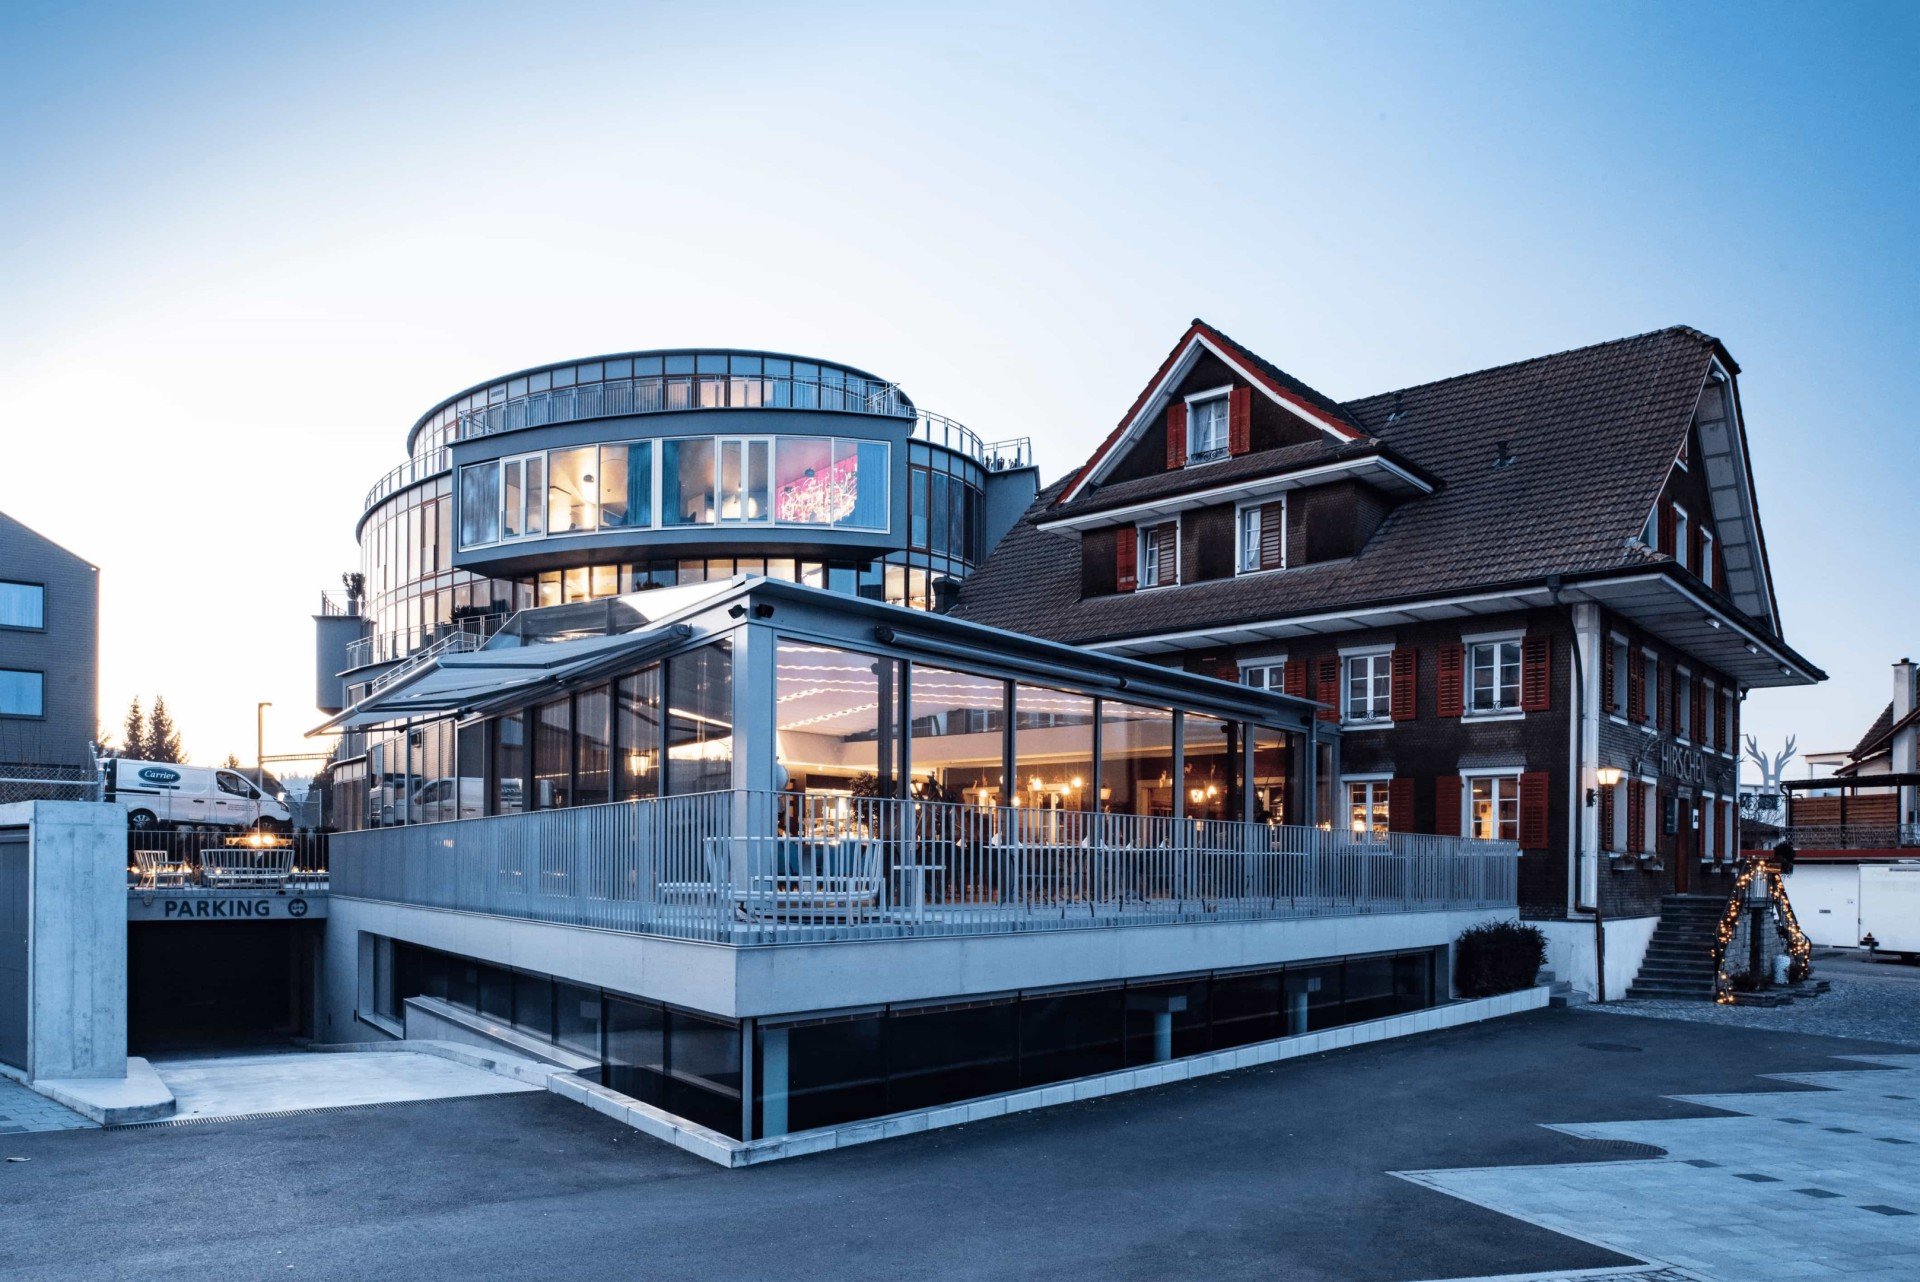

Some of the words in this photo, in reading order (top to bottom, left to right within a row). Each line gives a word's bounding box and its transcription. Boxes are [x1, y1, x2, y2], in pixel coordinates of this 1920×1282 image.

[1661, 742, 1708, 784] HIRSCHEN
[144, 770, 176, 780] Carrier
[164, 900, 270, 917] PARKING
